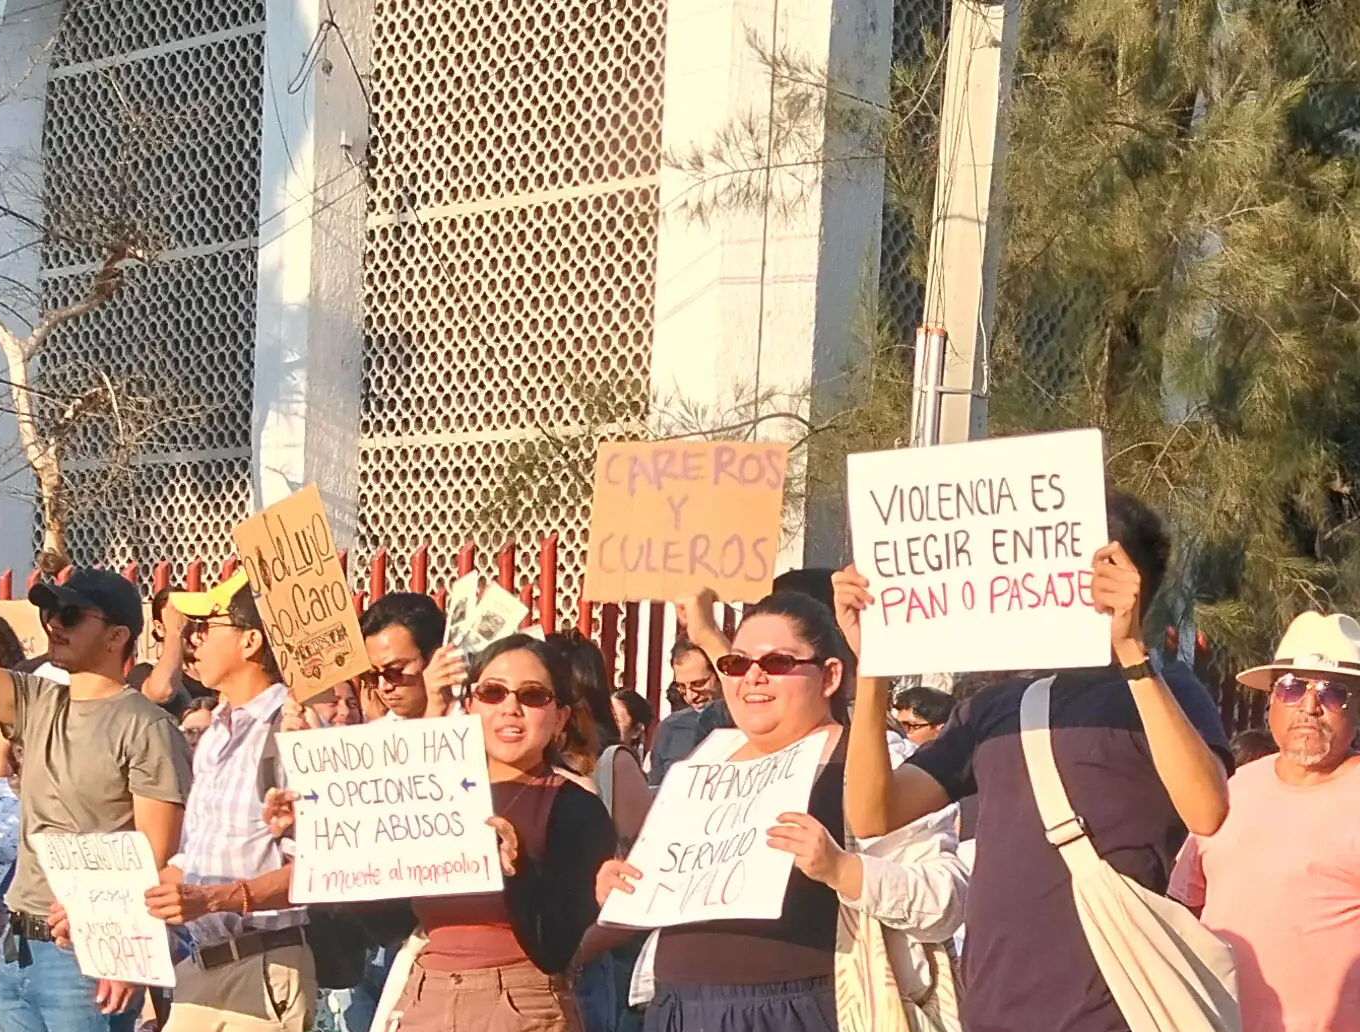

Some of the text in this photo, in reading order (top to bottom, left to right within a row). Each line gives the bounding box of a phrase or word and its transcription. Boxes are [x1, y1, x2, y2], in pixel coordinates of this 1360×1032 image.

[604, 445, 785, 496] CAREROS
[667, 494, 689, 531] Y
[869, 473, 1065, 526] VIOLENCIA ES
[599, 532, 770, 583] CULEROS
[874, 521, 1082, 578] ELEGIR ENTRE
[291, 580, 347, 626] Caro
[881, 570, 1096, 626] PAN O PASAJE
[293, 727, 469, 774] CUANDO NO HAY
[314, 810, 465, 850] HAY ABUSOS
[659, 827, 757, 874] SERVICIO
[389, 858, 403, 881] al
